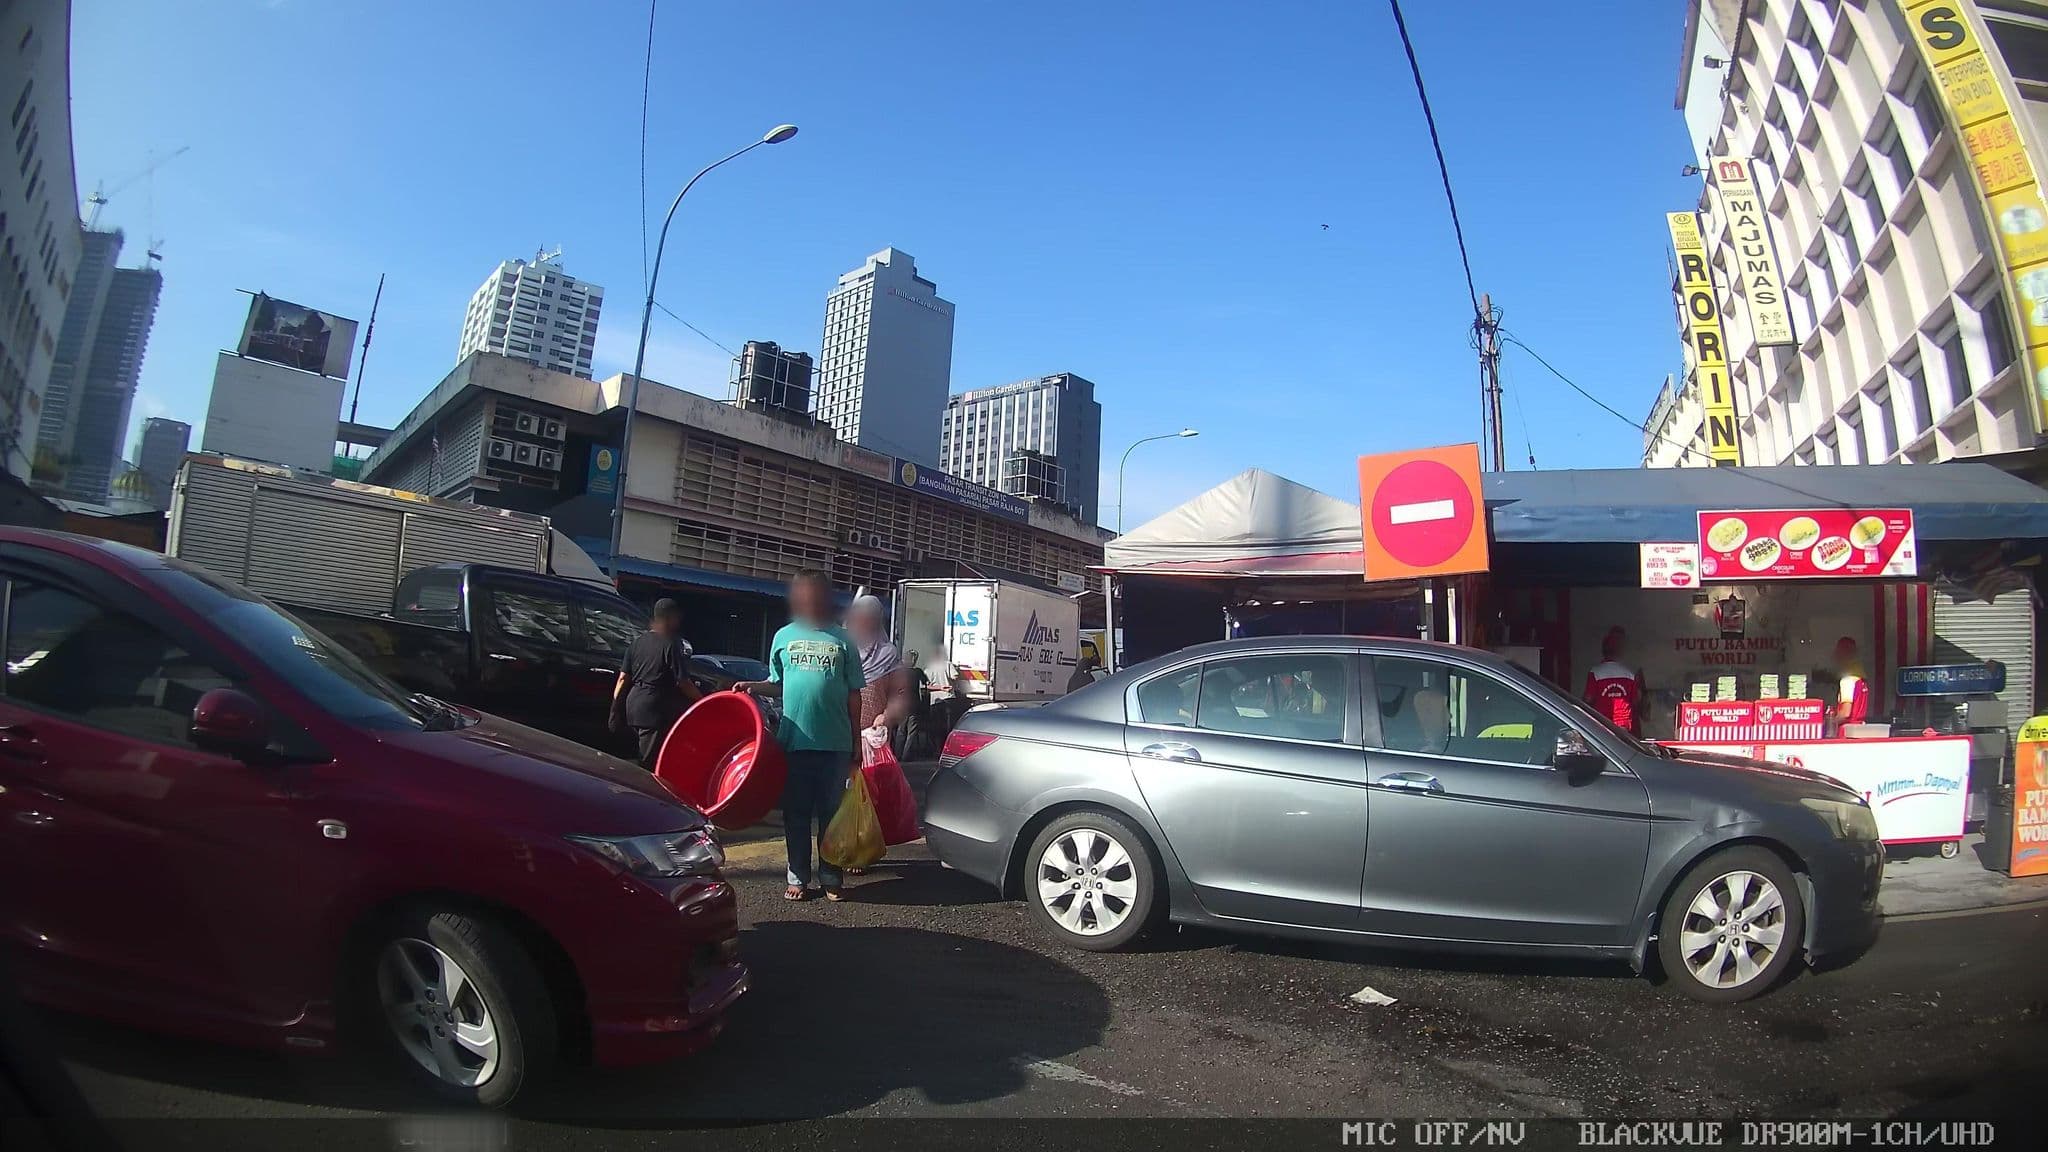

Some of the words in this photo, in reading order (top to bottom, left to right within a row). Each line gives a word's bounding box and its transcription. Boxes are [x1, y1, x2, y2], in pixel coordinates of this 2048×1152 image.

[1920, 6, 1966, 50] S
[1938, 57, 1988, 88] ENTERPRISE
[1951, 85, 1969, 106] SDN
[1731, 200, 1777, 305] MAJUMAS
[1680, 254, 1737, 468] RORIN
[1023, 379, 1037, 389] Inn
[944, 475, 963, 487] PASAR
[965, 480, 988, 497] TRANSIT
[982, 495, 1000, 508] PASAR
[1000, 502, 1015, 513] RAJA
[960, 633, 975, 645] ICE
[1675, 637, 1719, 650] PUTU
[790, 654, 836, 668] HATYAI
[1700, 652, 1757, 665] WORLD
[1903, 671, 1935, 682] LORONG
[1700, 708, 1721, 716] PUTU
